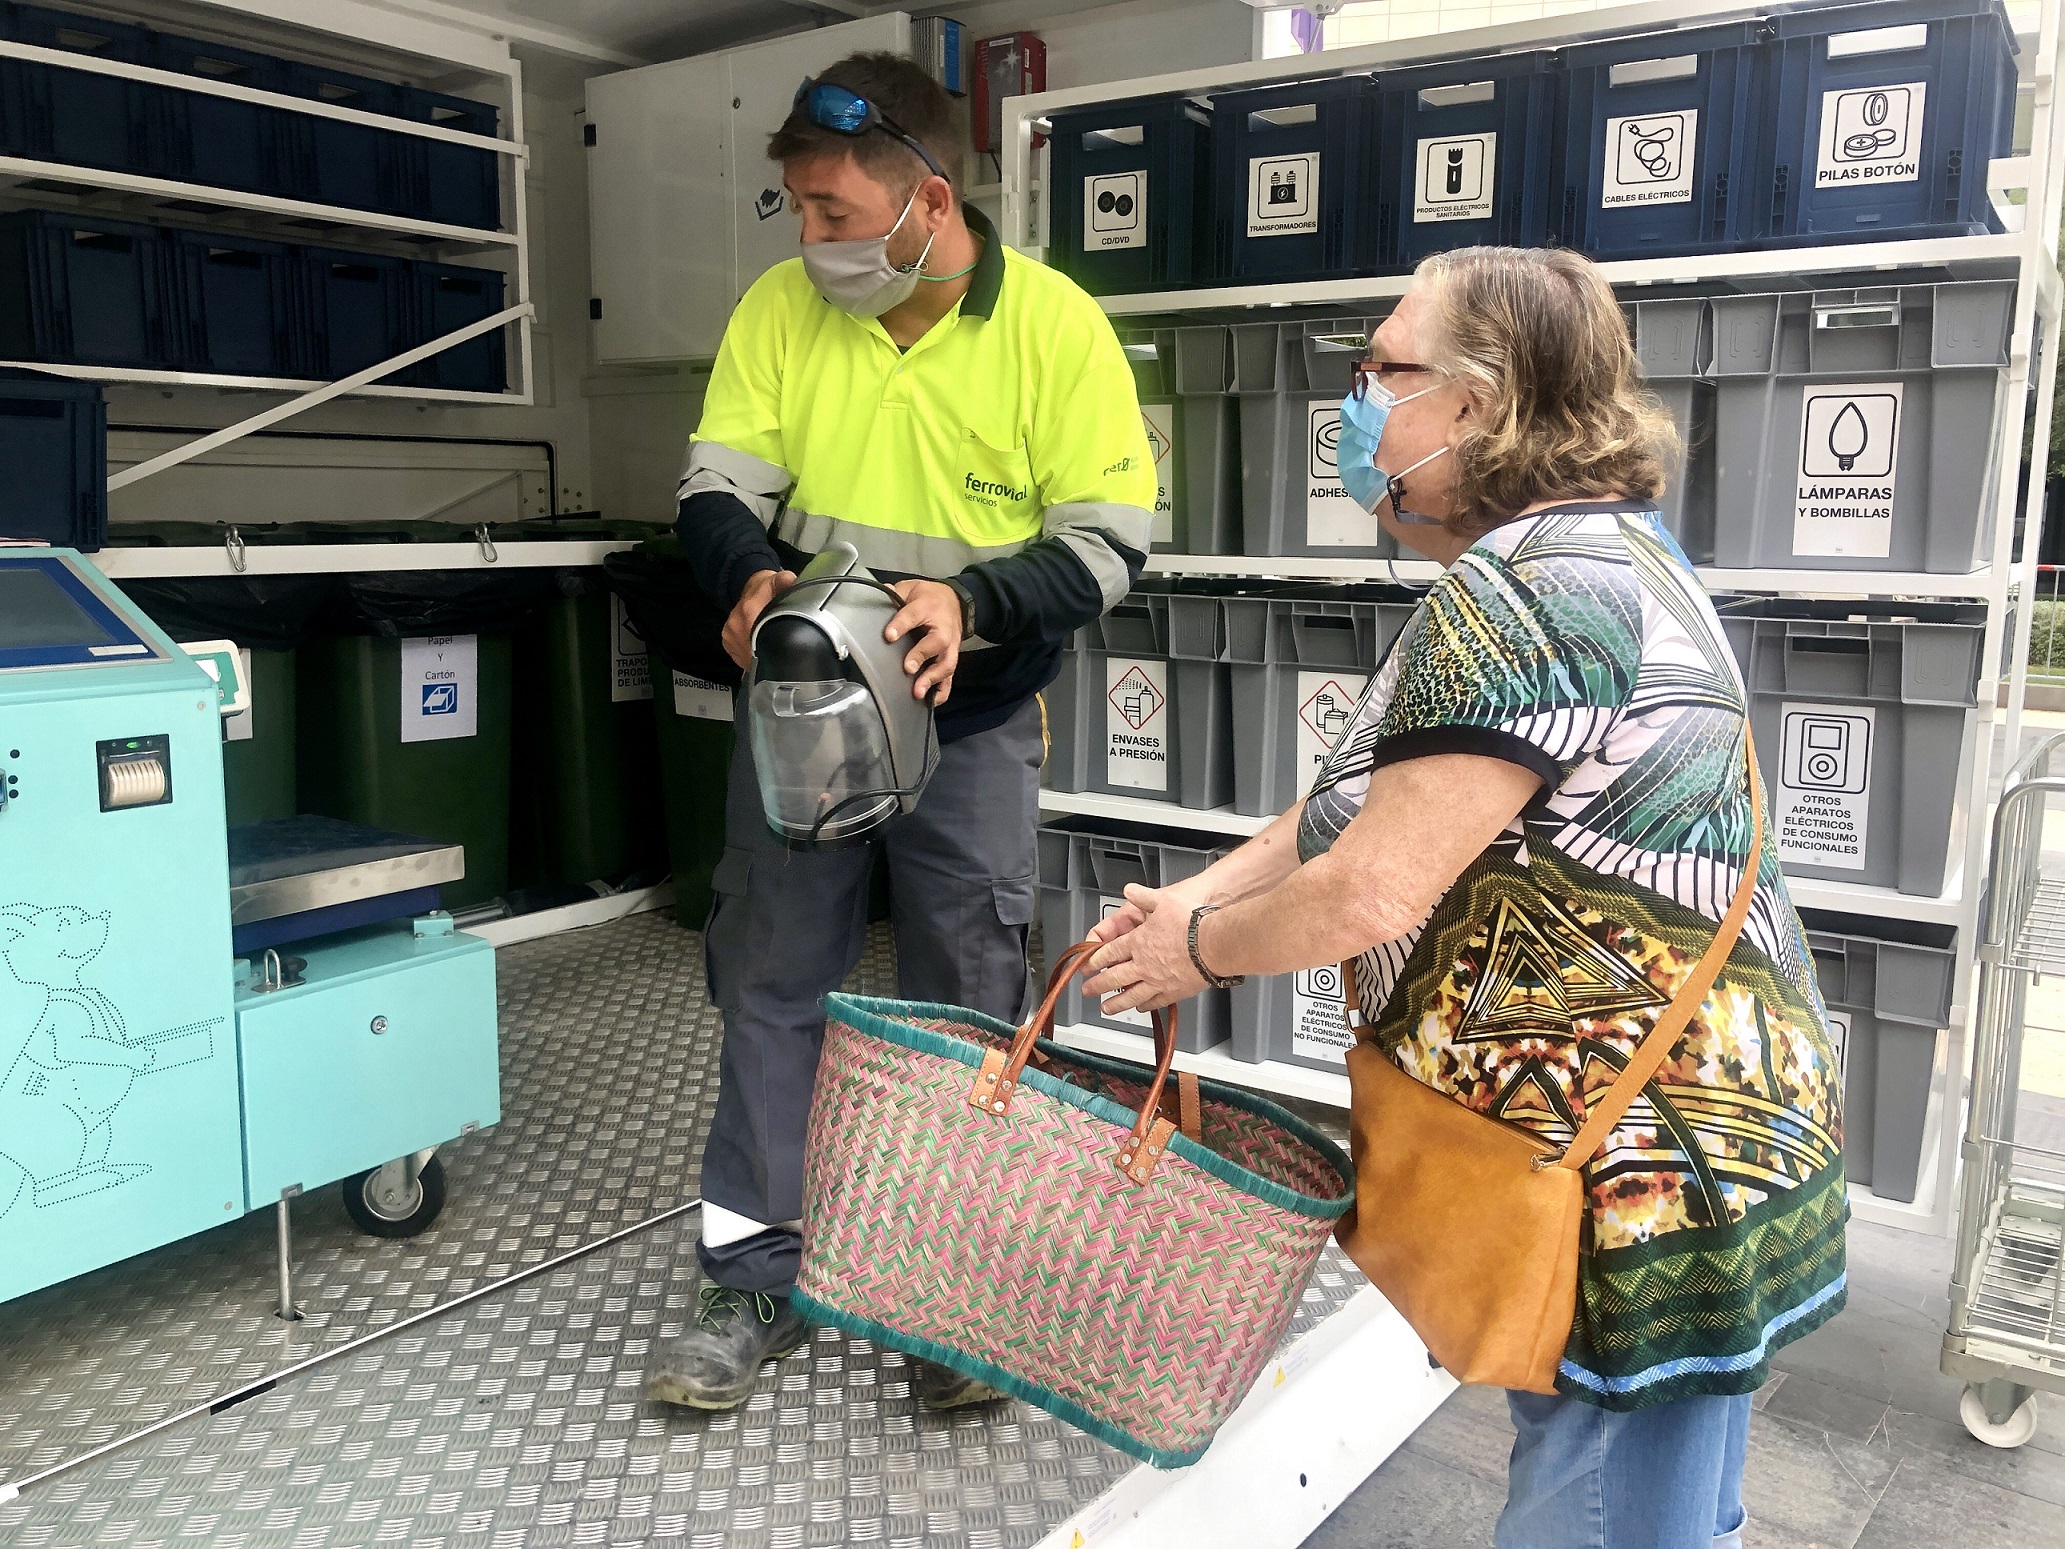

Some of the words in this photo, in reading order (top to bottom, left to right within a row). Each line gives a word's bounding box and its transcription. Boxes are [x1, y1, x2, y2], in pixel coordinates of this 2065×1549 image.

[1819, 168, 1859, 181] PILAS
[1864, 162, 1915, 178] BOTÓN
[1605, 194, 1636, 203] CABLES
[1638, 190, 1690, 200] ELÉCTRICOS
[1454, 203, 1489, 211] ELÉCTRICOS
[1249, 221, 1316, 232] TRANSFORMADORES
[1102, 236, 1130, 245] CD/DVD
[965, 472, 1027, 501] ferrovial
[1799, 485, 1892, 500] LÁMPARAS
[1310, 488, 1351, 498] ADHES
[964, 493, 997, 507] servicios
[1798, 508, 1807, 517] Y
[1811, 508, 1890, 518] BOMBILLAS
[428, 636, 453, 646] Papel
[616, 658, 647, 667] TRAPO
[425, 670, 455, 679] Cartón
[617, 667, 649, 677] PRODU
[617, 678, 630, 687] DE
[675, 678, 730, 692] ABSORBENTES
[1112, 734, 1159, 748] ENVASES
[1110, 747, 1117, 756] A
[1119, 748, 1165, 761] PRESIÓN
[1803, 795, 1841, 806] OTROS
[1792, 806, 1851, 818] APARATOS
[1785, 816, 1854, 831] ELÉCTRICOS
[1783, 828, 1797, 837] DE
[1800, 829, 1858, 842] CONSUMO
[1781, 839, 1858, 855] FUNCIONALES
[1313, 1002, 1338, 1011] OTROS
[1306, 1009, 1345, 1021] APARATOS
[1302, 1016, 1348, 1030] ELÉCTRICOS
[1294, 1032, 1305, 1040] NO
[1312, 1027, 1350, 1040] CONSUMO
